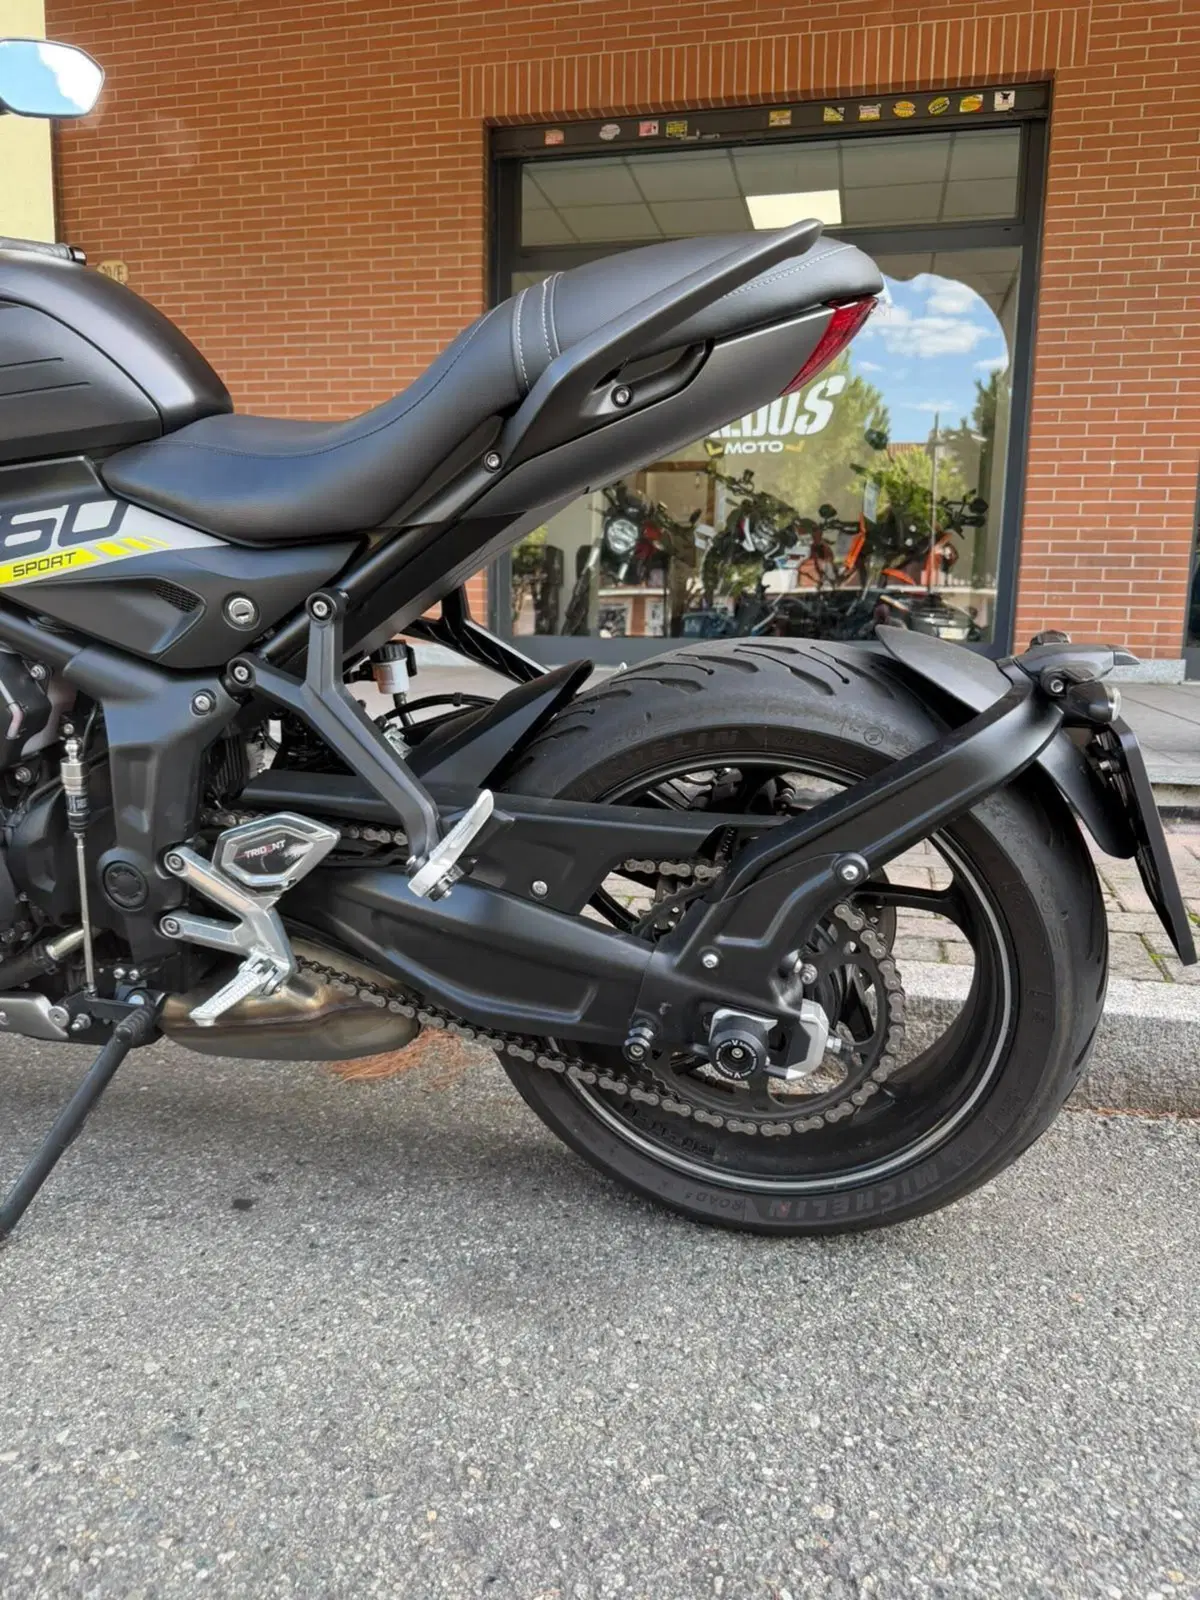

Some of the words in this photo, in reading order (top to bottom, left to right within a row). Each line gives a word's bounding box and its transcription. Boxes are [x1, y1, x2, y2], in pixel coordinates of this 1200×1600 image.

[724, 440, 785, 455] MOTO
[13, 552, 77, 578] SPORT
[244, 839, 287, 859] TRIDENT
[768, 1166, 940, 1219] MICHELIN
